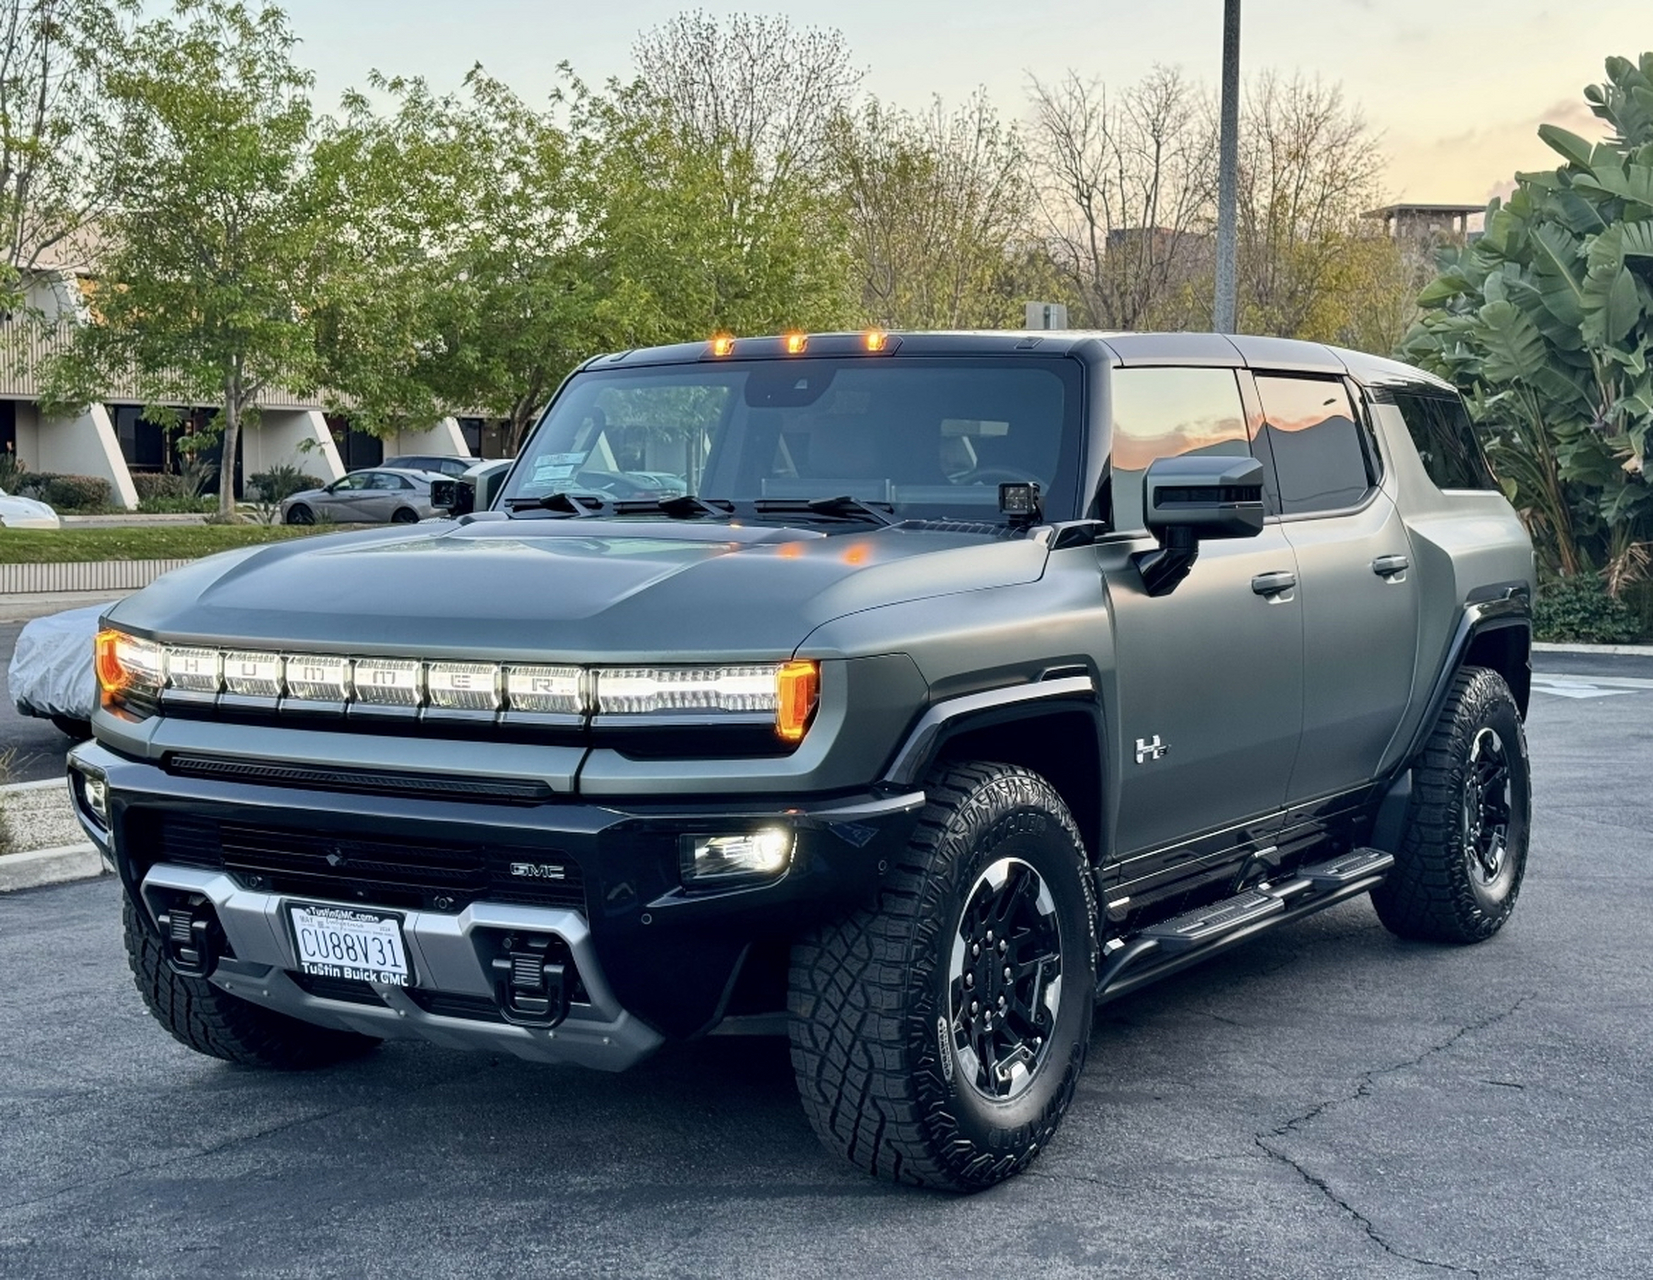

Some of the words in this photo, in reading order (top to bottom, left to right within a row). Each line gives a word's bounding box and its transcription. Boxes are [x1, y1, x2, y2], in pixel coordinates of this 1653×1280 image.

[185, 659, 553, 693] HUMMER
[510, 862, 565, 879] GMC
[301, 928, 402, 968] CU88V31
[301, 962, 340, 978] Tustin
[344, 967, 378, 983] Buick
[380, 971, 409, 987] GMC
